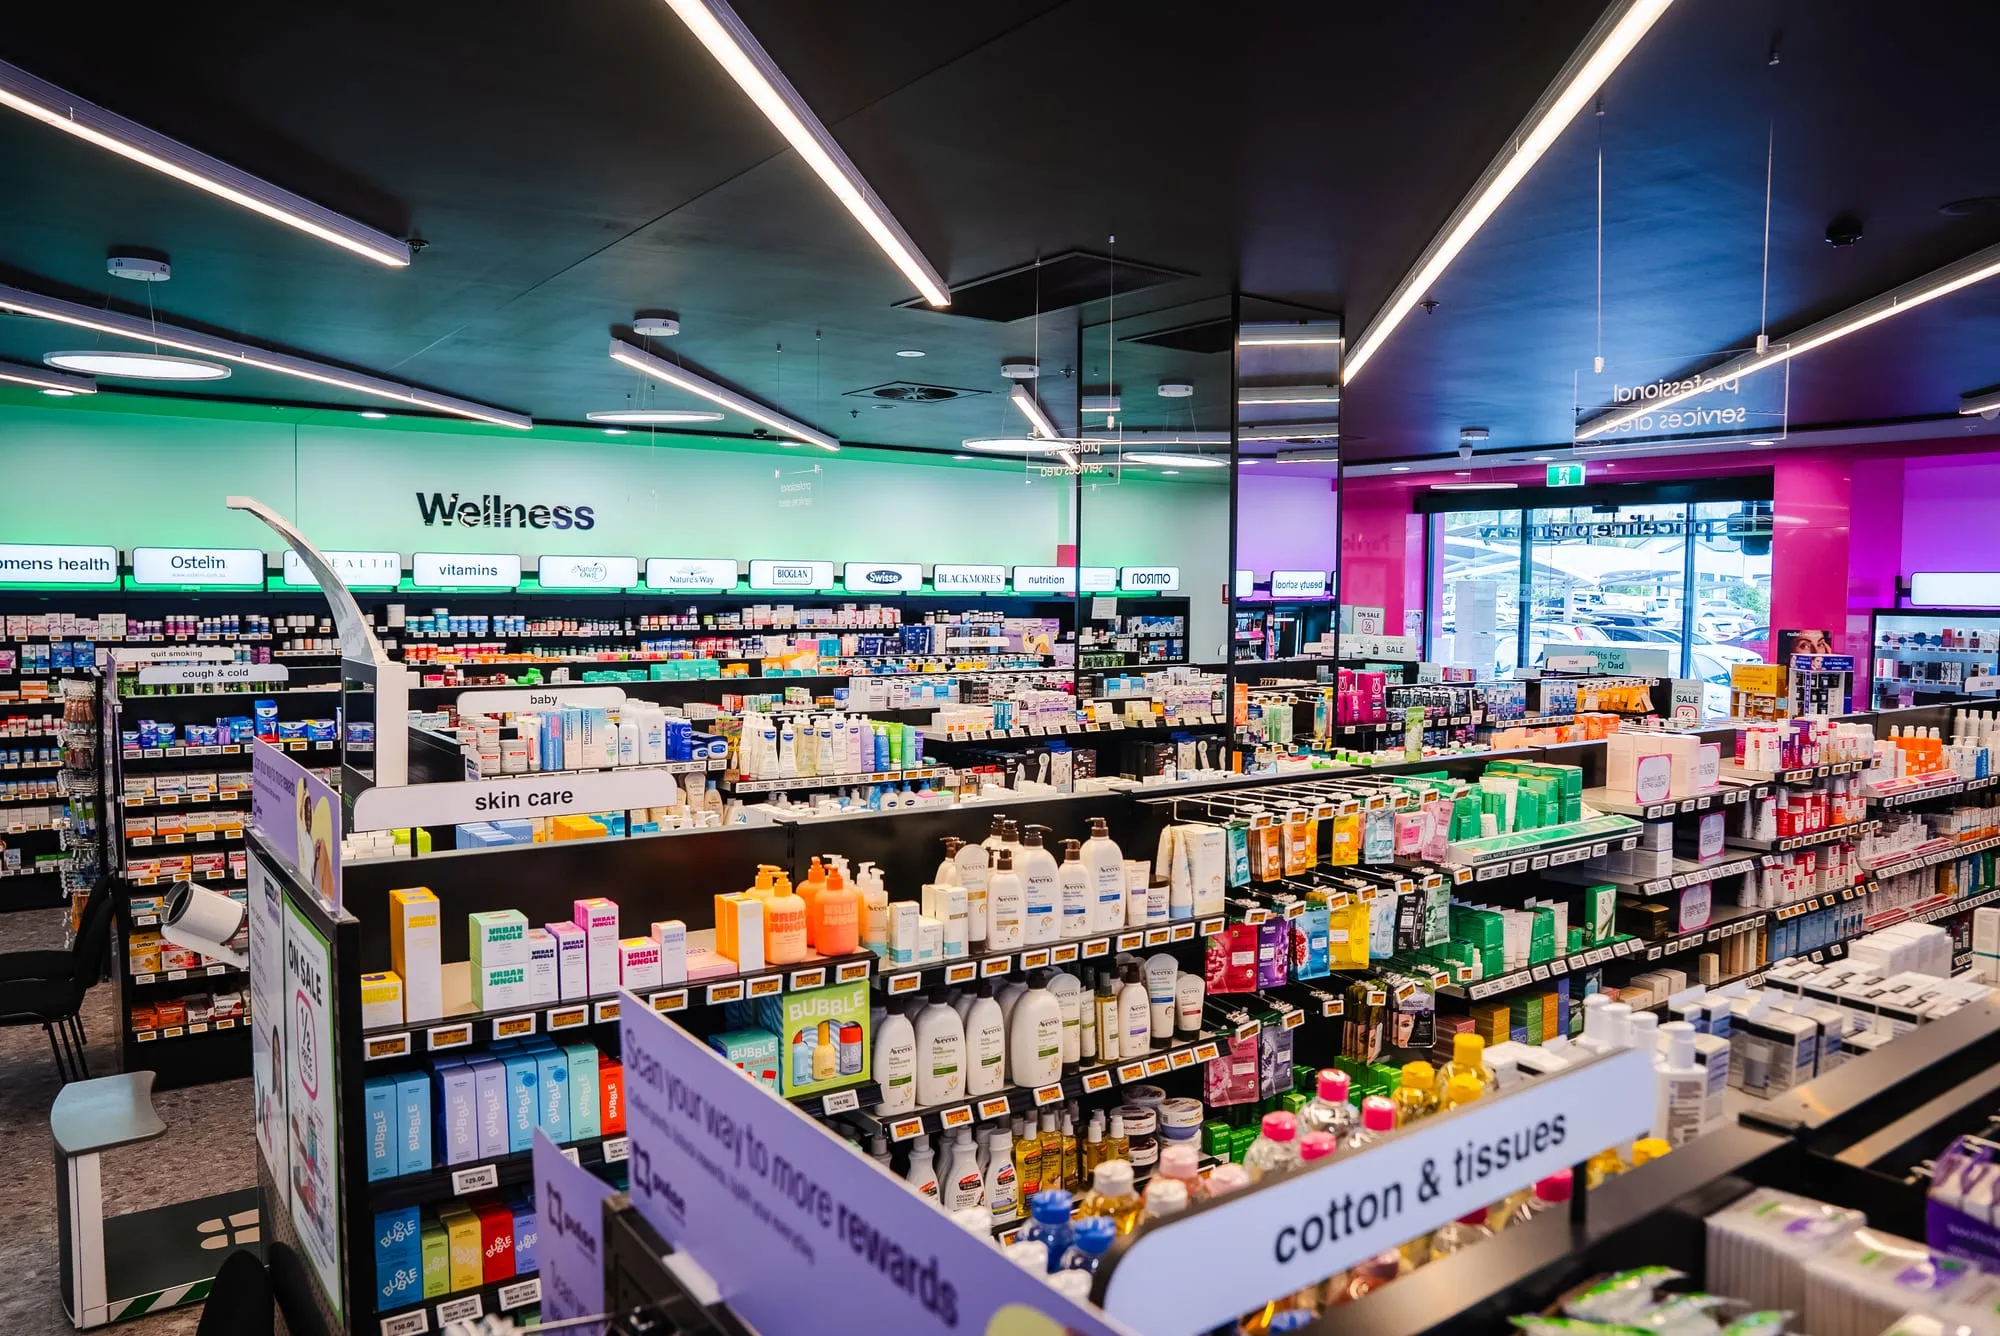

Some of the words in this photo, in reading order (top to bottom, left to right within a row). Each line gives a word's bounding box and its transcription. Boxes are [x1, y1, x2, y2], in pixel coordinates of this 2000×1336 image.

[416, 492, 596, 530] Wellness
[58, 556, 111, 572] health
[171, 555, 225, 569] Ostelin
[292, 557, 393, 569] JEALTH
[438, 563, 499, 577] vitamins
[777, 569, 808, 578] BIOGLAN
[669, 575, 699, 584] Nature's
[699, 576, 715, 586] Way
[868, 571, 900, 582] Swisse
[938, 573, 1001, 585] BLACKMORES
[1028, 574, 1065, 585] nutrition
[151, 650, 167, 659] quit
[168, 649, 203, 659] smoking
[1385, 645, 1404, 654] SALE
[1609, 652, 1621, 661] for
[1607, 661, 1625, 670] Dad
[182, 669, 215, 681] cough
[216, 670, 226, 679] &
[227, 668, 250, 678] cold
[1420, 675, 1438, 684] SALE
[529, 693, 558, 707] baby
[1675, 694, 1699, 705] SALE
[475, 791, 521, 811] skin
[527, 788, 574, 808] care
[1028, 873, 1054, 886] Aveeno
[1064, 882, 1086, 891] Aveeno
[591, 920, 616, 929] JUNGLE
[592, 915, 616, 923] URBAN
[488, 924, 523, 936] URBAN
[487, 931, 523, 943] JUNGLE
[562, 939, 585, 947] URBAN
[561, 943, 585, 951] JUNGLE
[530, 952, 555, 960] JUNGLE
[627, 949, 659, 960] URBAN
[626, 955, 659, 967] JUNGLE
[288, 939, 300, 979] ON
[300, 953, 322, 1007] SALE
[488, 968, 524, 980] URBAN
[488, 975, 524, 987] JUNGLE
[788, 988, 866, 1023] BUBBLE
[933, 1034, 959, 1046] Aveeno
[730, 1041, 777, 1061] BUBBLE
[889, 1045, 913, 1056] Aveeno
[547, 1077, 562, 1125] BUBBLE
[609, 1082, 618, 1119] BUBBLE
[484, 1088, 501, 1139] BUBBLE
[515, 1084, 530, 1131] BUBBLE
[452, 1094, 470, 1145] BUBBLE
[407, 1103, 423, 1152] BUBBLE
[373, 1109, 388, 1159] BUBBLE
[624, 1027, 664, 1094] Scan
[665, 1067, 703, 1124] your
[703, 1102, 744, 1170] way
[744, 1123, 769, 1179] to
[771, 1151, 834, 1229] more
[836, 1202, 961, 1329] rewards
[1274, 1180, 1403, 1265] cotton
[1417, 1157, 1441, 1203] &
[1453, 1111, 1568, 1188] tissues
[380, 1219, 417, 1248] BUBBLE
[485, 1234, 513, 1259] BUBBLE
[382, 1266, 418, 1298] BUBBLE
